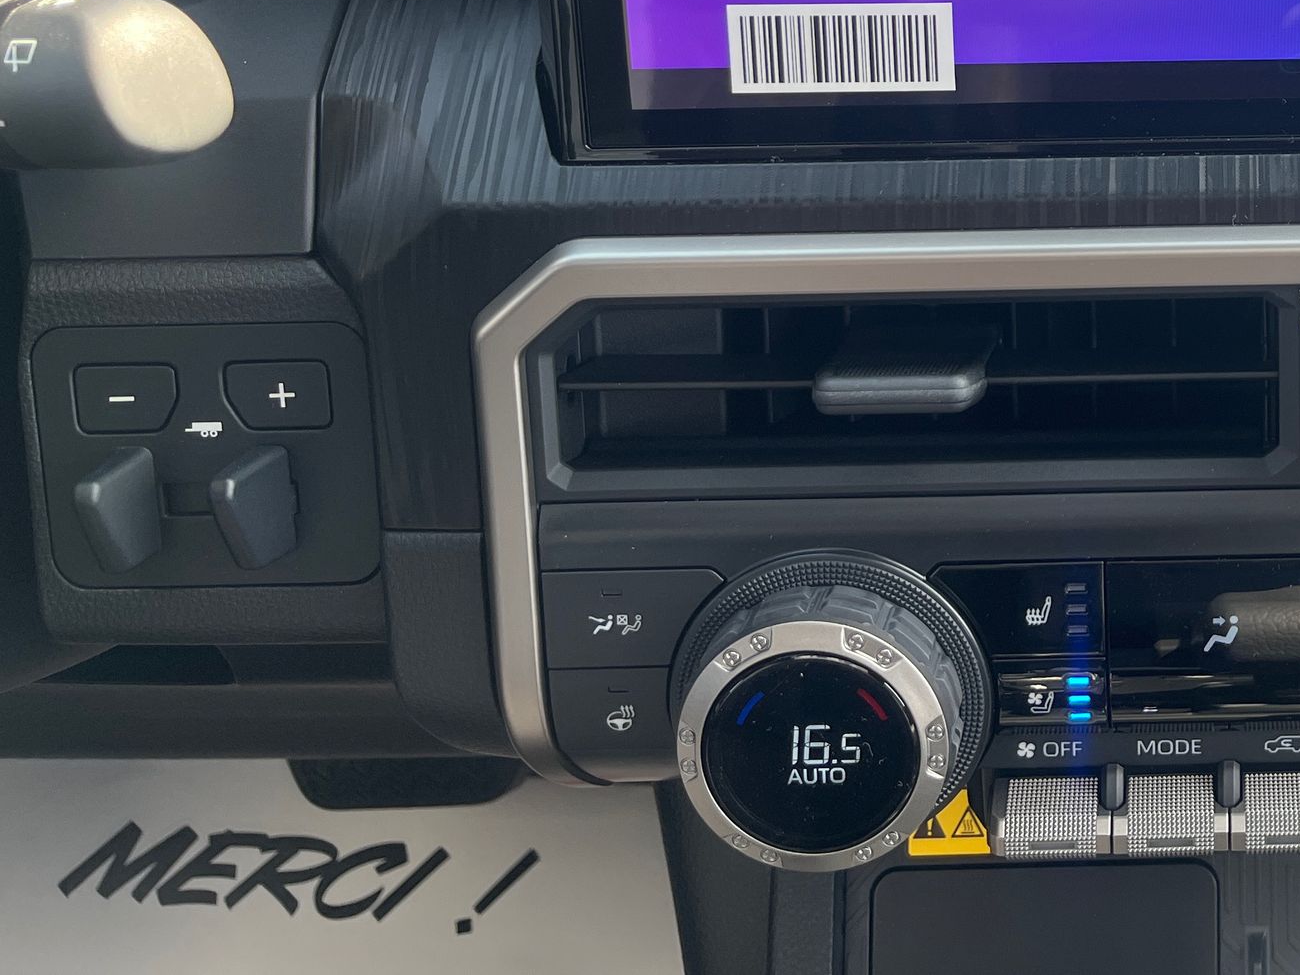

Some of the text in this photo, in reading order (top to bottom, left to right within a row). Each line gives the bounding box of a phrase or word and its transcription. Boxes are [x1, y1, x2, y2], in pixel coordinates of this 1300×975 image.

[791, 724, 861, 765] 16.5
[1043, 741, 1083, 757] OFF
[1137, 739, 1202, 755] MODE
[787, 768, 846, 785] AUTO
[57, 821, 451, 921] MERCI
